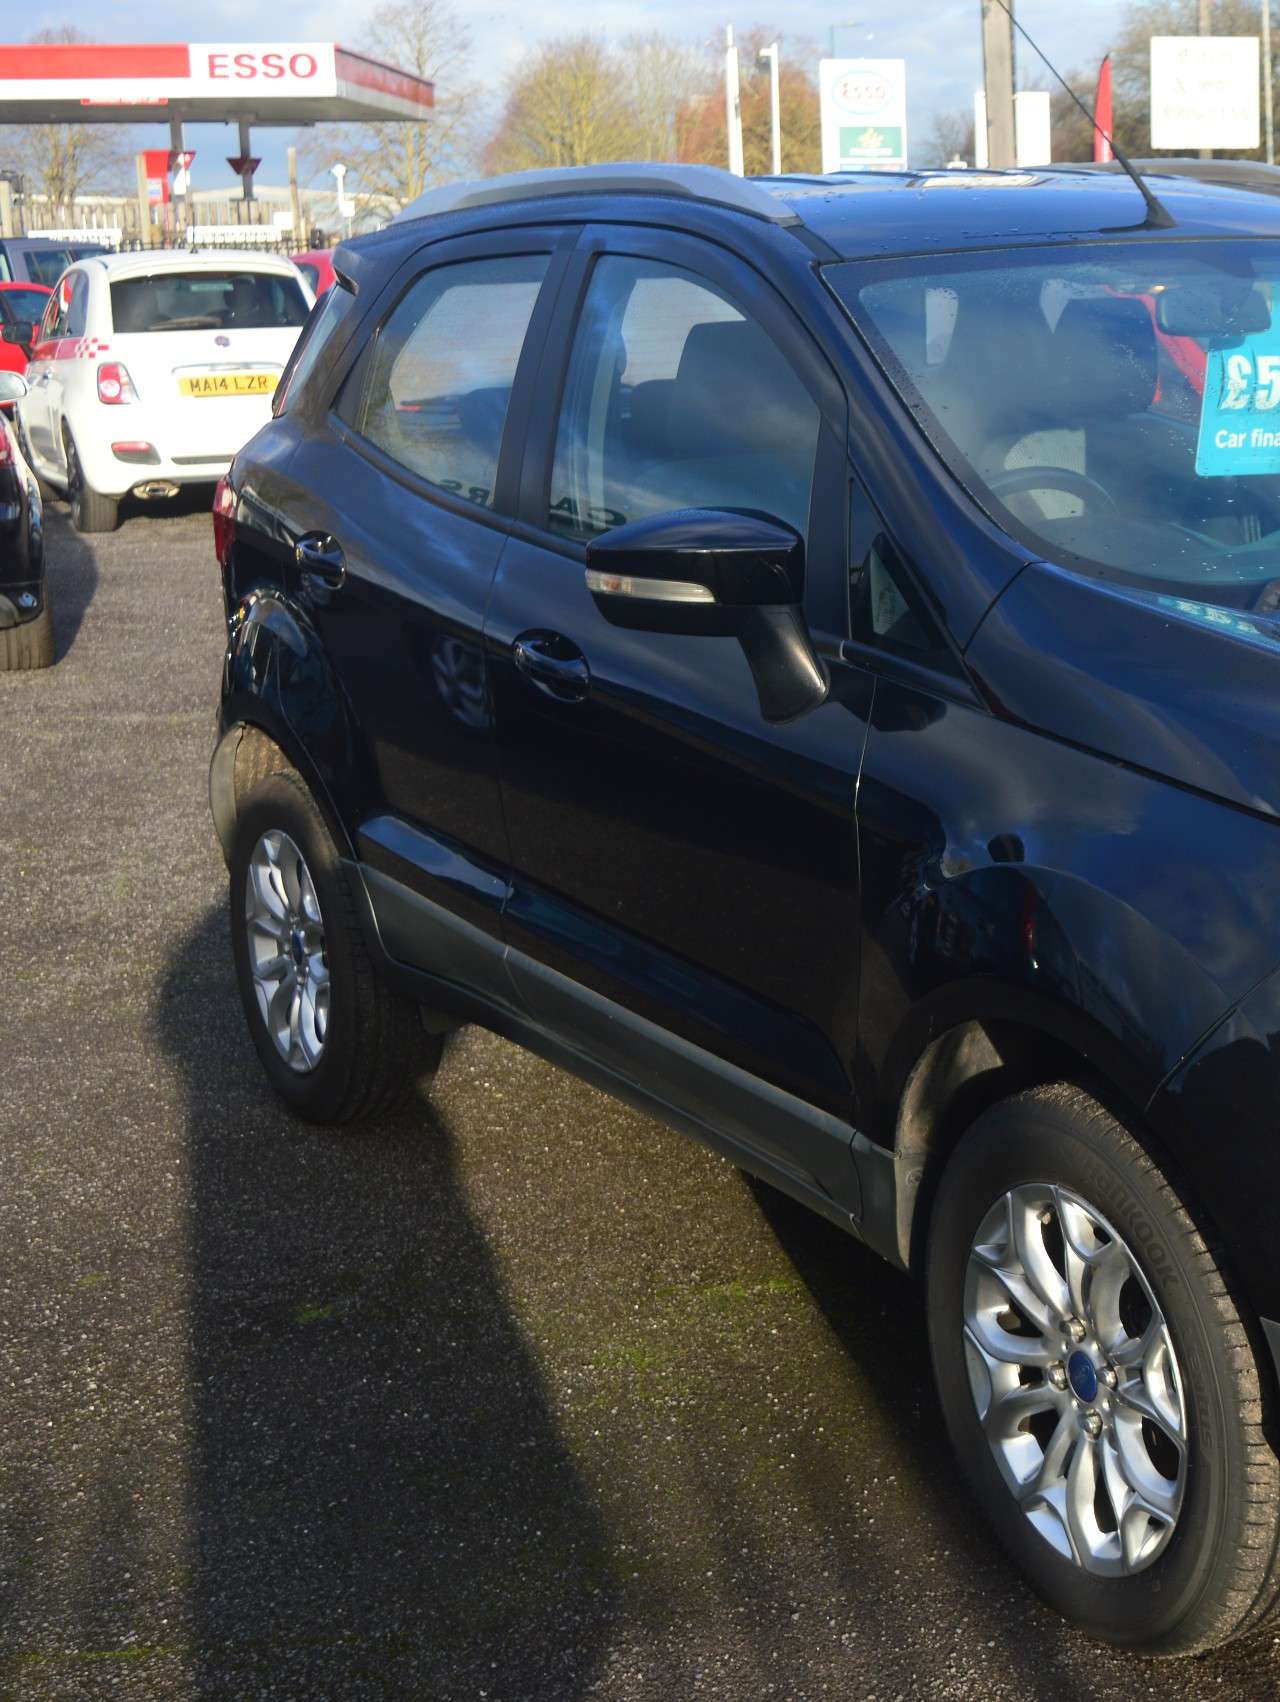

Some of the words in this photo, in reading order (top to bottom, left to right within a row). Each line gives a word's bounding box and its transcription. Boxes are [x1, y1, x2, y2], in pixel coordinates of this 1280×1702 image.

[207, 53, 318, 79] ESSO
[189, 376, 228, 393] MA14
[234, 374, 268, 391] LZR
[1214, 429, 1247, 449] Car
